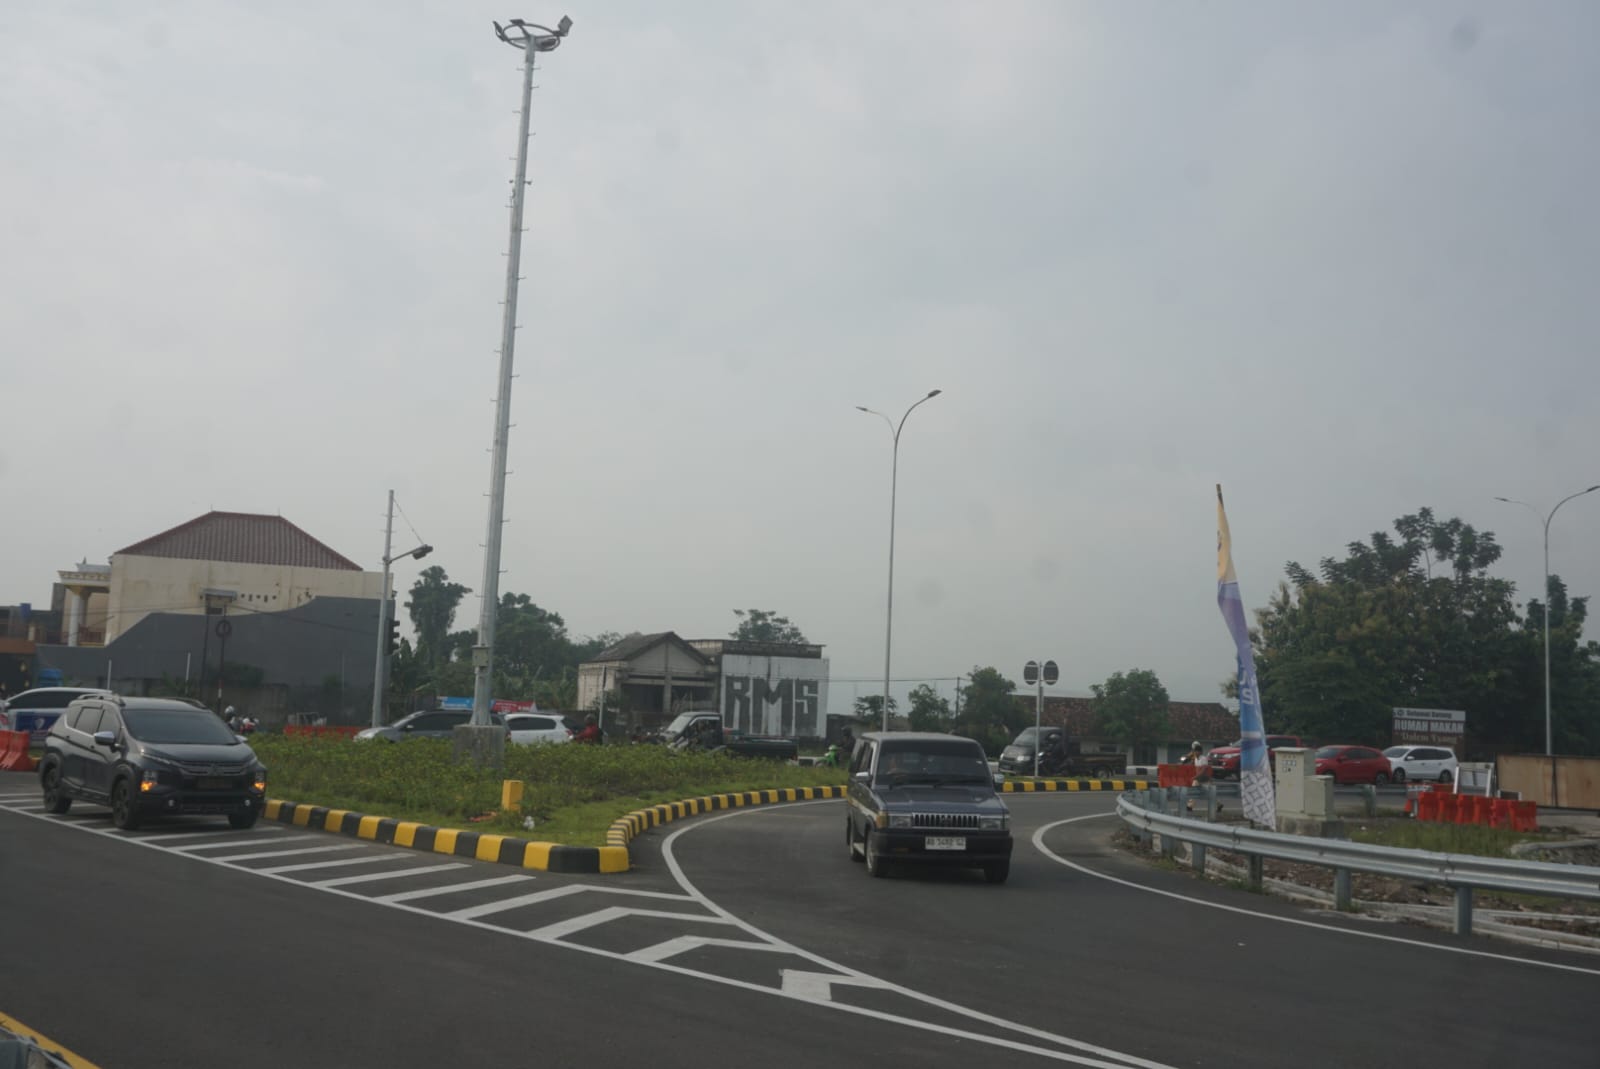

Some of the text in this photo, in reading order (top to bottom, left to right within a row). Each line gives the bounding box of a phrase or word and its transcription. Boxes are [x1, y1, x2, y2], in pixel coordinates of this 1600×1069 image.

[724, 676, 819, 736] RMS
[1394, 719, 1464, 734] RUMAH MAKAN
